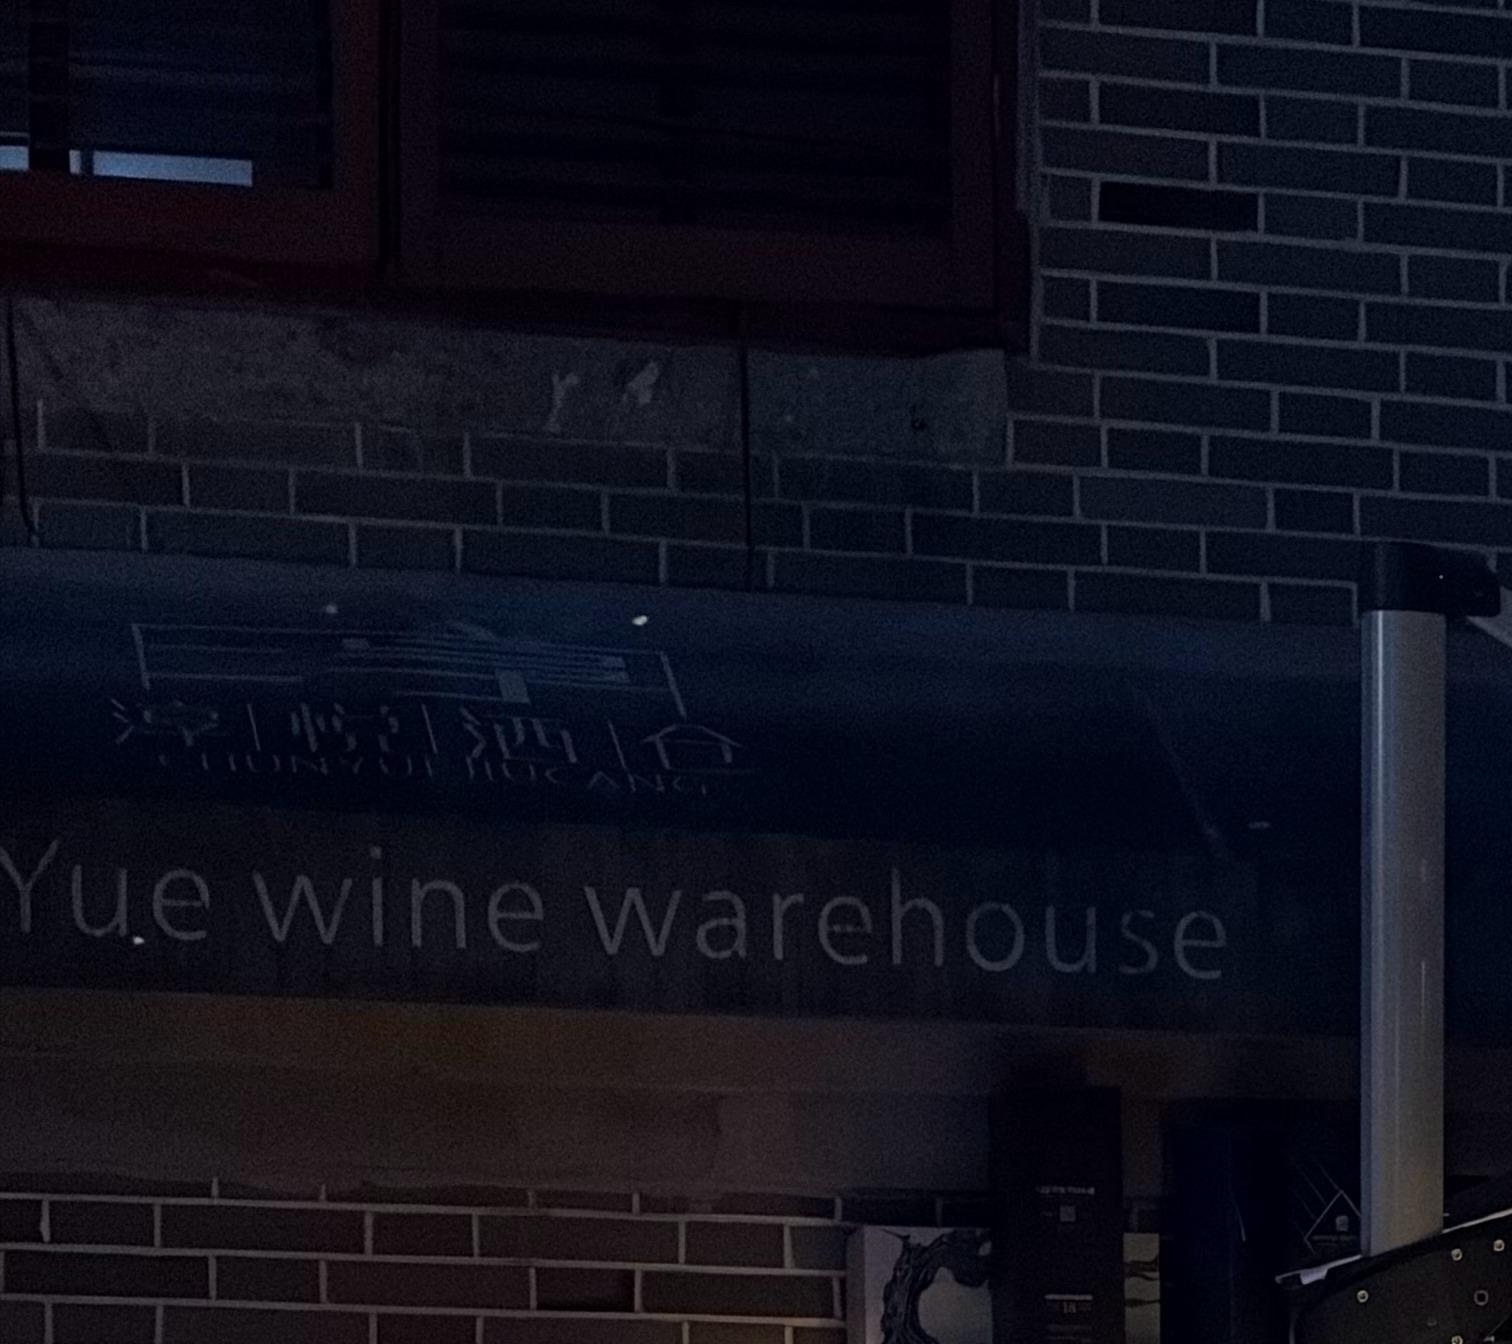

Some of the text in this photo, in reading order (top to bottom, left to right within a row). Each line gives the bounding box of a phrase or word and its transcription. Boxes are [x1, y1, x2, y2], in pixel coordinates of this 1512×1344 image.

[0, 838, 1227, 980] Yue wine warehouse
